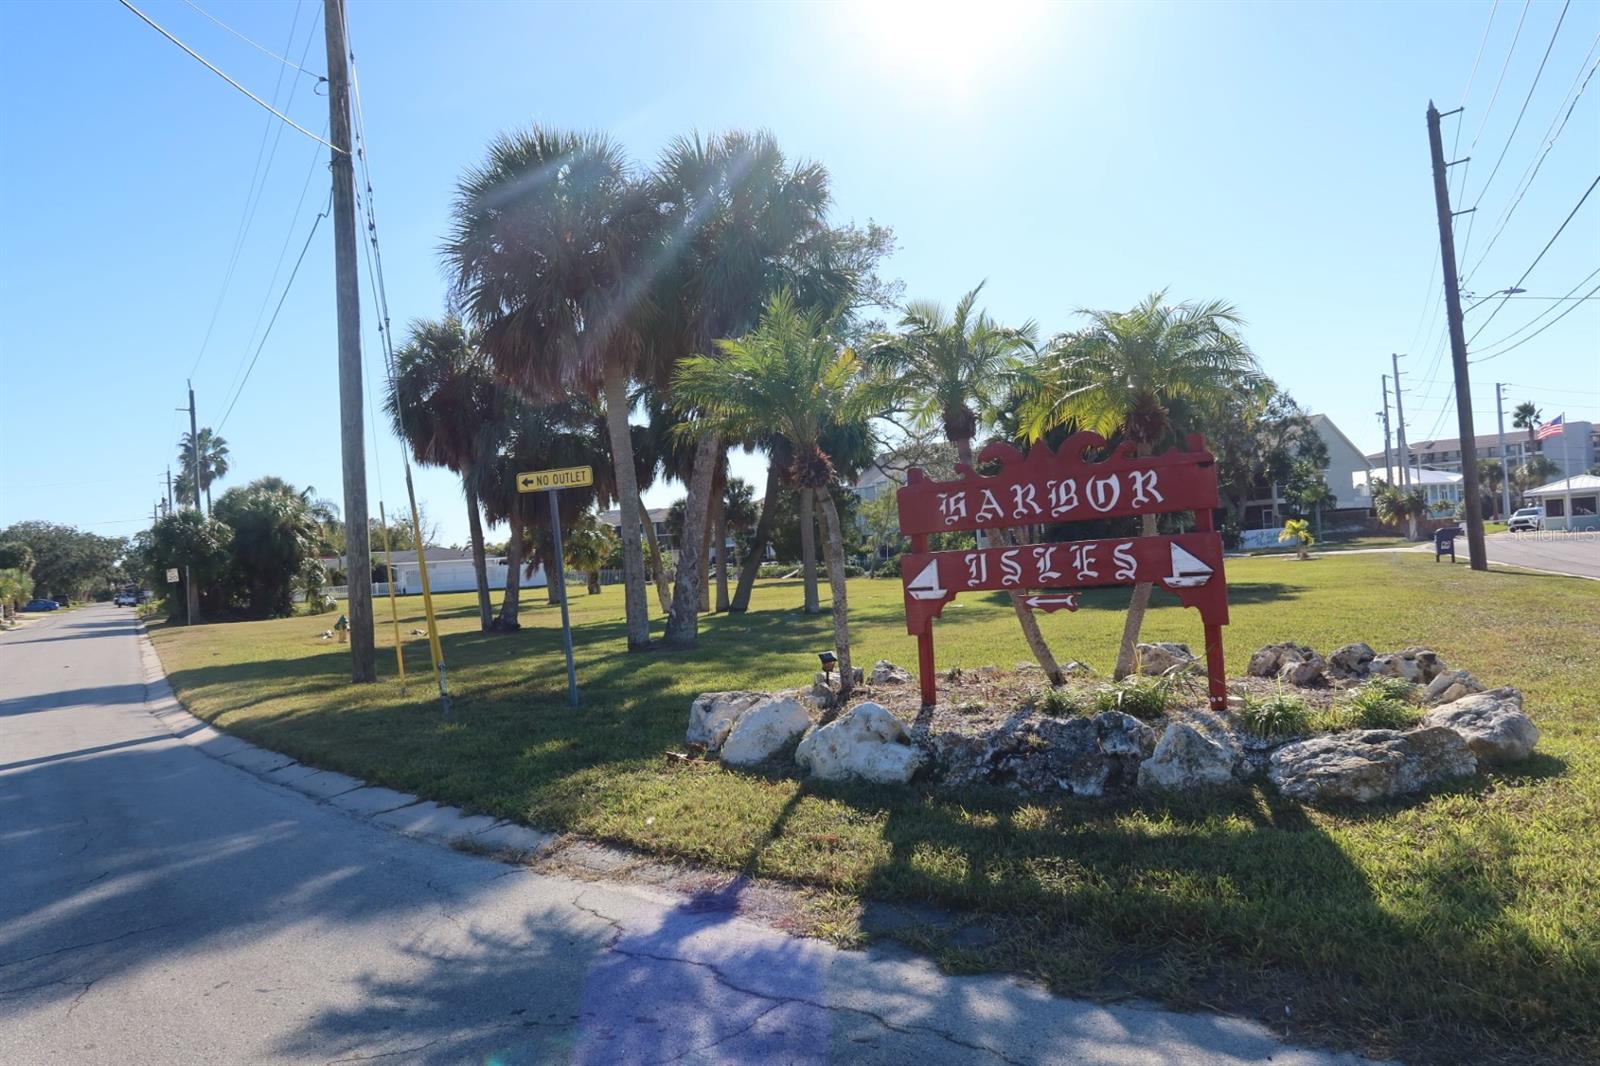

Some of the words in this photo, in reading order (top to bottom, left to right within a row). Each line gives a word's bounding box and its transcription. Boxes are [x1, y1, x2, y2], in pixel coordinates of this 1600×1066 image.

[537, 475, 549, 486] NO
[553, 471, 586, 484] OUTLET
[938, 469, 1164, 525] HARBOR
[966, 542, 1137, 587] ISLES
